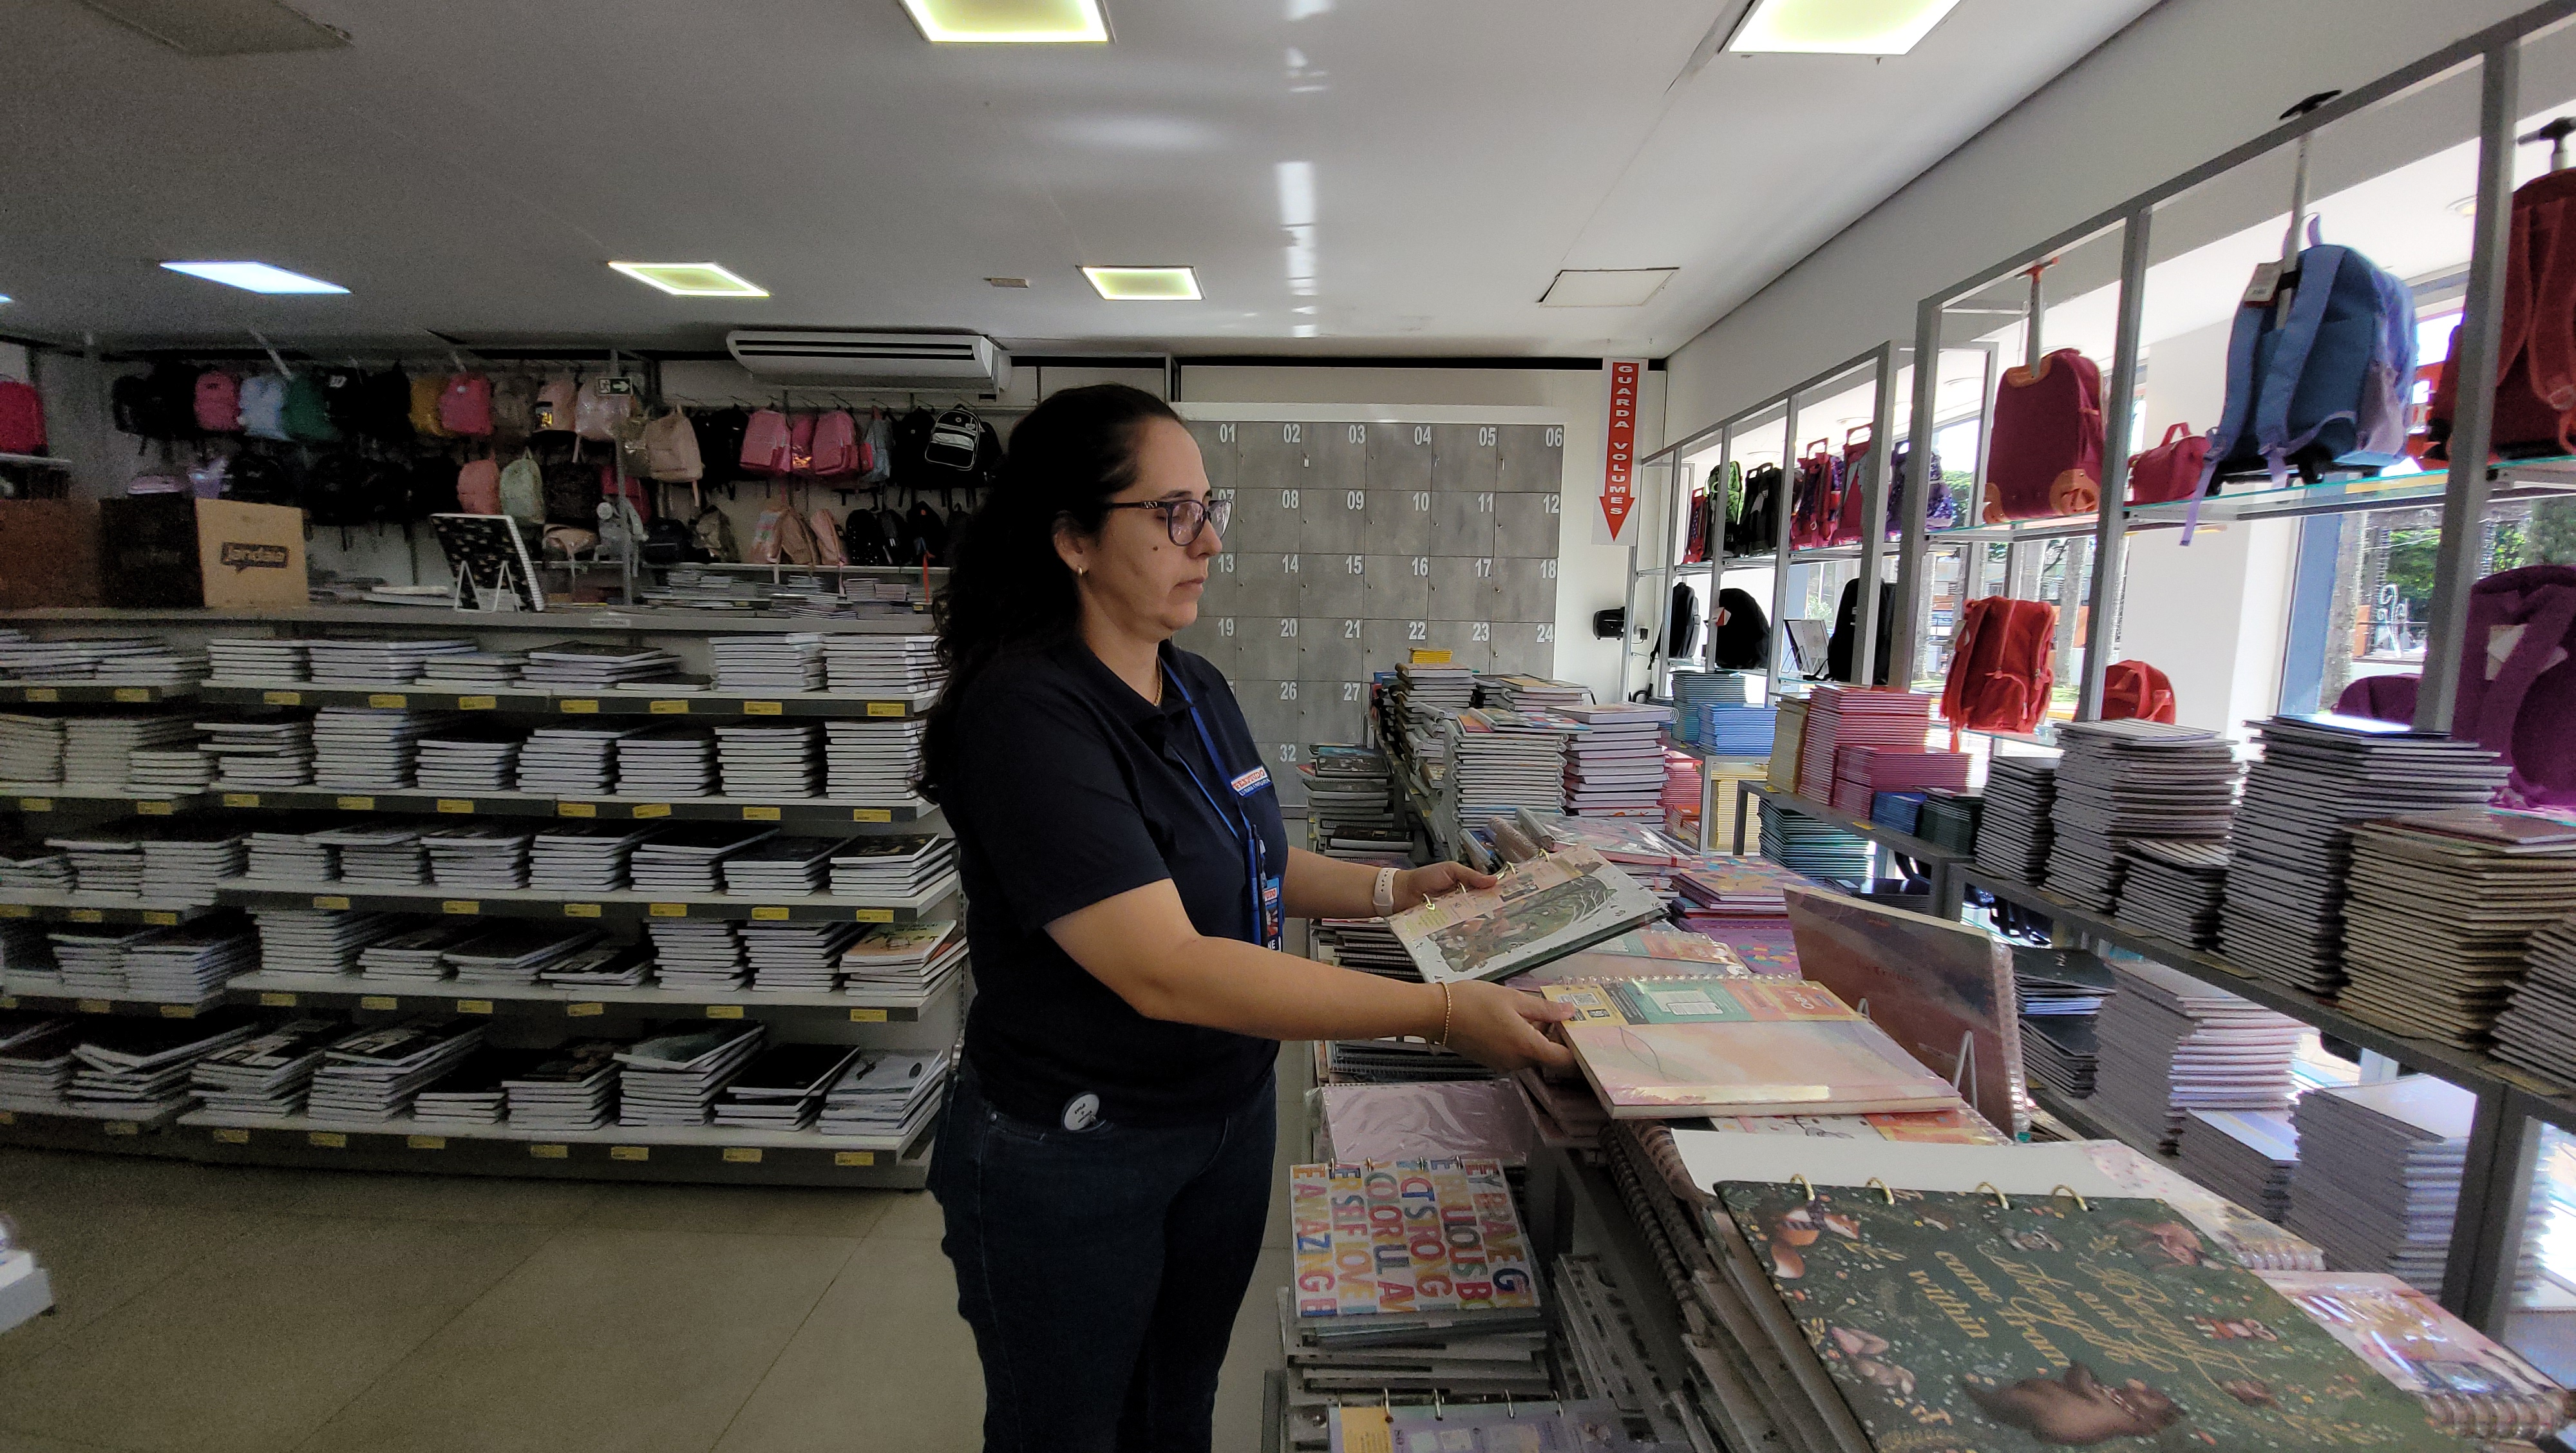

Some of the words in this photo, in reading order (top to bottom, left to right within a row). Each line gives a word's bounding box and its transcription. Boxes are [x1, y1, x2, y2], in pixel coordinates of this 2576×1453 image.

[1613, 365, 1633, 428] GUARDA
[1220, 424, 1235, 442] 01
[1283, 424, 1300, 442] 02
[1349, 425, 1365, 444] 03
[1414, 426, 1431, 445] 04
[1479, 427, 1496, 446] 05
[1546, 428, 1563, 447] 06
[1609, 442, 1629, 515] VOLUMES
[1282, 490, 1299, 509] 08
[1347, 491, 1364, 509] 09
[1412, 493, 1429, 511] 10
[1478, 493, 1493, 512] 11
[1543, 494, 1559, 513] 12
[1218, 555, 1234, 573] 13
[1282, 555, 1299, 573] 14
[1346, 556, 1363, 575] 15
[1412, 557, 1428, 576] 16
[1475, 558, 1492, 576] 17
[1540, 560, 1557, 578] 18
[1218, 618, 1234, 637] 19
[1280, 619, 1297, 638] 20
[1345, 620, 1361, 638] 21
[1408, 622, 1426, 640] 22
[1472, 623, 1490, 641] 23
[1537, 624, 1554, 643] 24
[1280, 681, 1297, 700] 26
[1343, 683, 1361, 702] 27
[1280, 744, 1296, 763] 32
[1908, 1269, 1990, 1338] within
[1934, 1250, 2003, 1304] come
[1995, 1306, 2070, 1367] from
[2074, 1291, 2143, 1329] and
